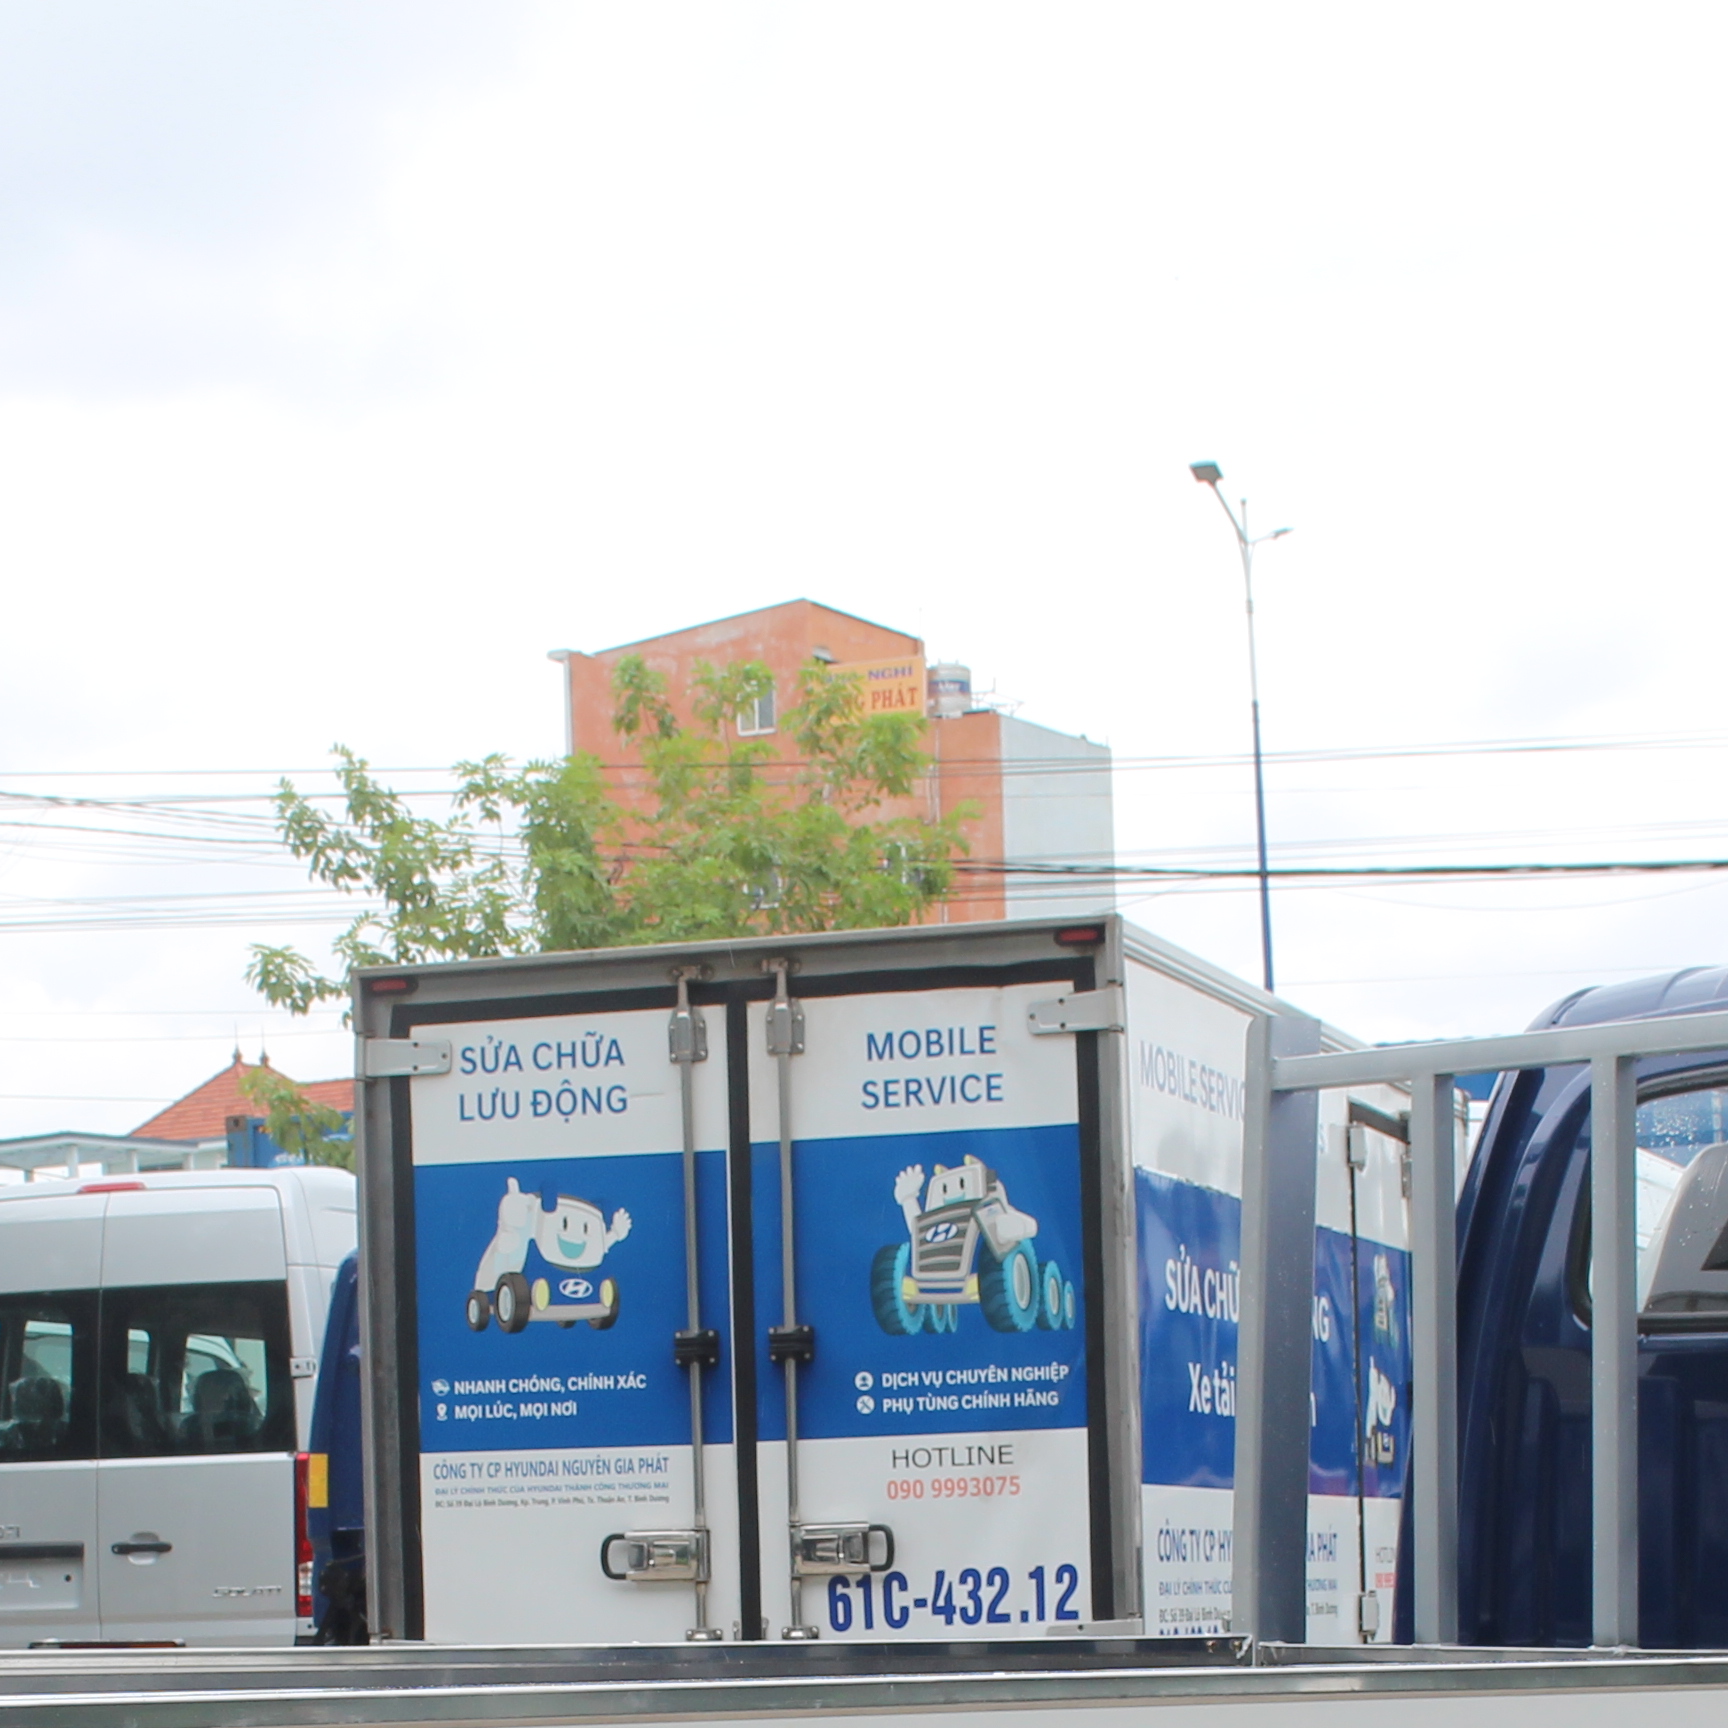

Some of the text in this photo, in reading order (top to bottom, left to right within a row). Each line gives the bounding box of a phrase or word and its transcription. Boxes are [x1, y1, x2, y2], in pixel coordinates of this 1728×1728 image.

[872, 682, 918, 709] PHÁT
[460, 1031, 625, 1075] SỬA CHỮA
[867, 1025, 996, 1061] MOBILE
[861, 1073, 1003, 1109] SERVICE
[1140, 1040, 1245, 1123] MOBILE SERVIC
[459, 1078, 628, 1123] LƯU ĐỘNG
[1165, 1243, 1202, 1316] SỬA
[1204, 1260, 1241, 1324] CHỮ
[454, 1370, 647, 1395] NHANH CHÓNG, CHÍNH XÁC
[882, 1361, 1069, 1390] DỊCH VỤ CHUYÊN NGHIỆP
[1188, 1361, 1235, 1417] Xe tải
[454, 1400, 577, 1422] MỌI LÚC, MỌI NƠI
[883, 1388, 1060, 1415] PHỤ TÙNG CHÍNH HÃNG
[433, 1459, 467, 1480] CÔNG
[470, 1462, 484, 1478] TY
[487, 1462, 501, 1478] CP
[505, 1460, 559, 1478] HYUNDAI
[615, 1458, 634, 1474] GIA
[638, 1452, 669, 1473] PHÁT
[892, 1444, 1014, 1469] HOTLINE
[887, 1475, 1021, 1500] 090 9993075
[1158, 1518, 1187, 1562] CÔNG
[1189, 1529, 1201, 1562] TY
[1204, 1529, 1215, 1562] CP
[827, 1563, 1080, 1632] 61C-432.12
